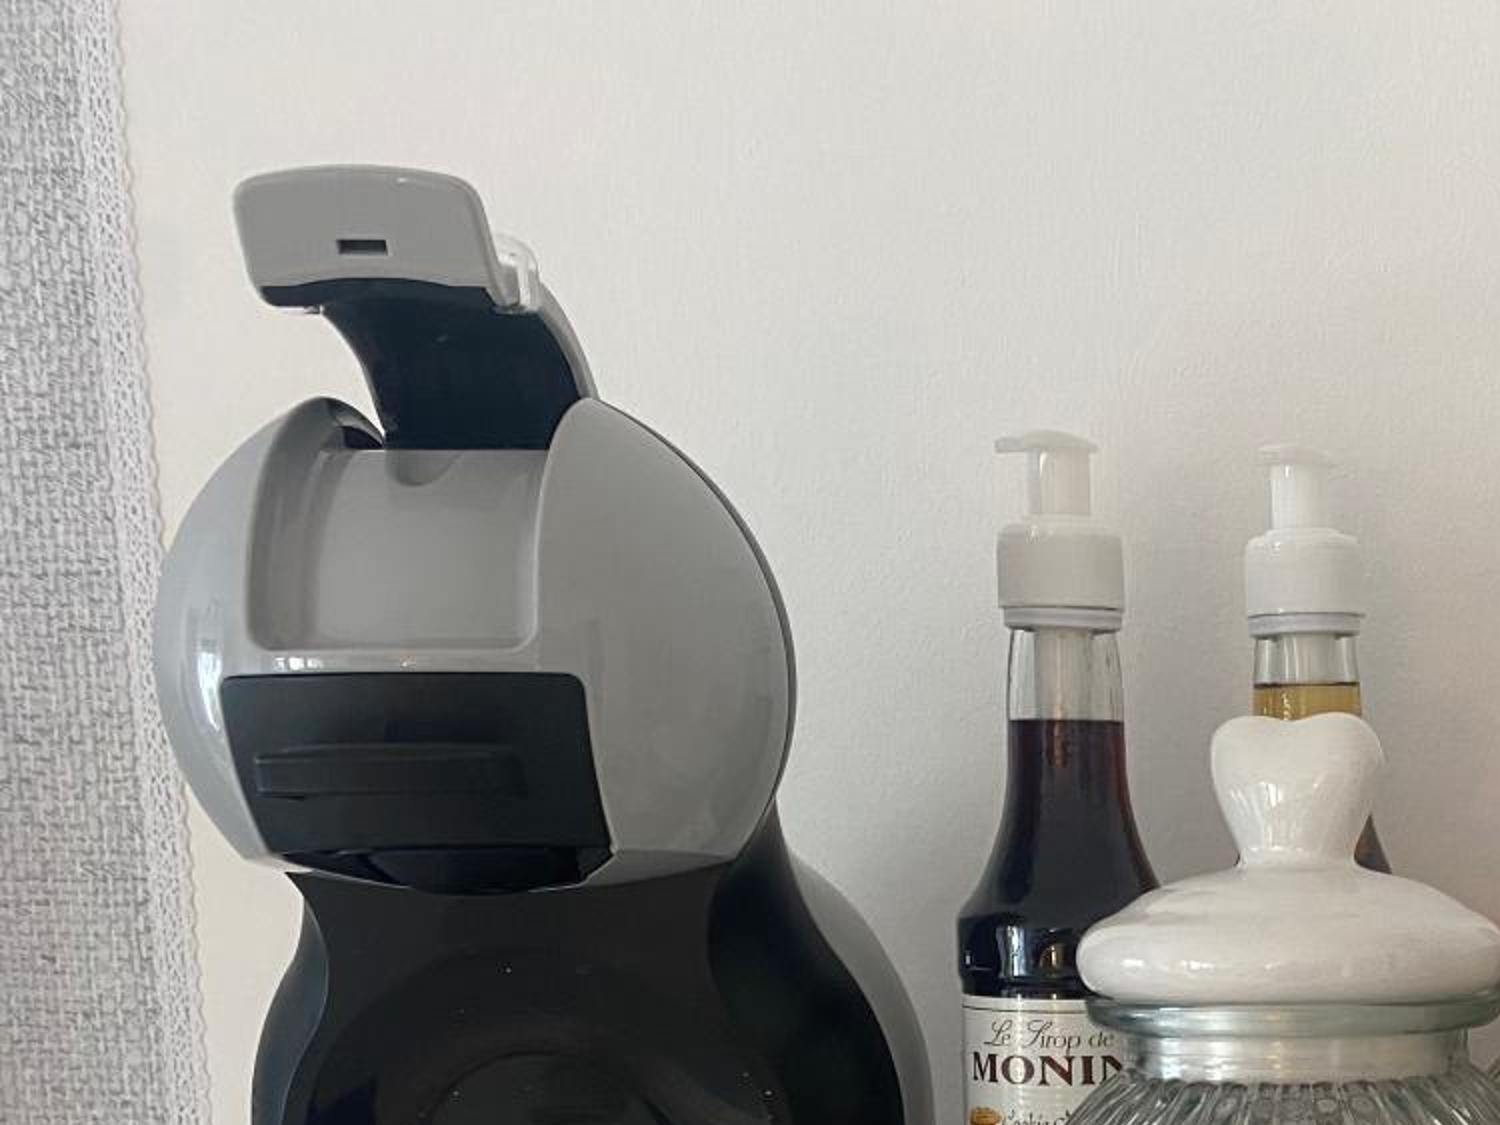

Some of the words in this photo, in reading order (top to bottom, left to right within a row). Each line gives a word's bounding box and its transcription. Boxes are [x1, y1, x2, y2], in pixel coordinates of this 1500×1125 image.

[983, 1019, 1013, 1047] Le
[1022, 1019, 1082, 1055] Sirop
[1088, 1031, 1116, 1048] de
